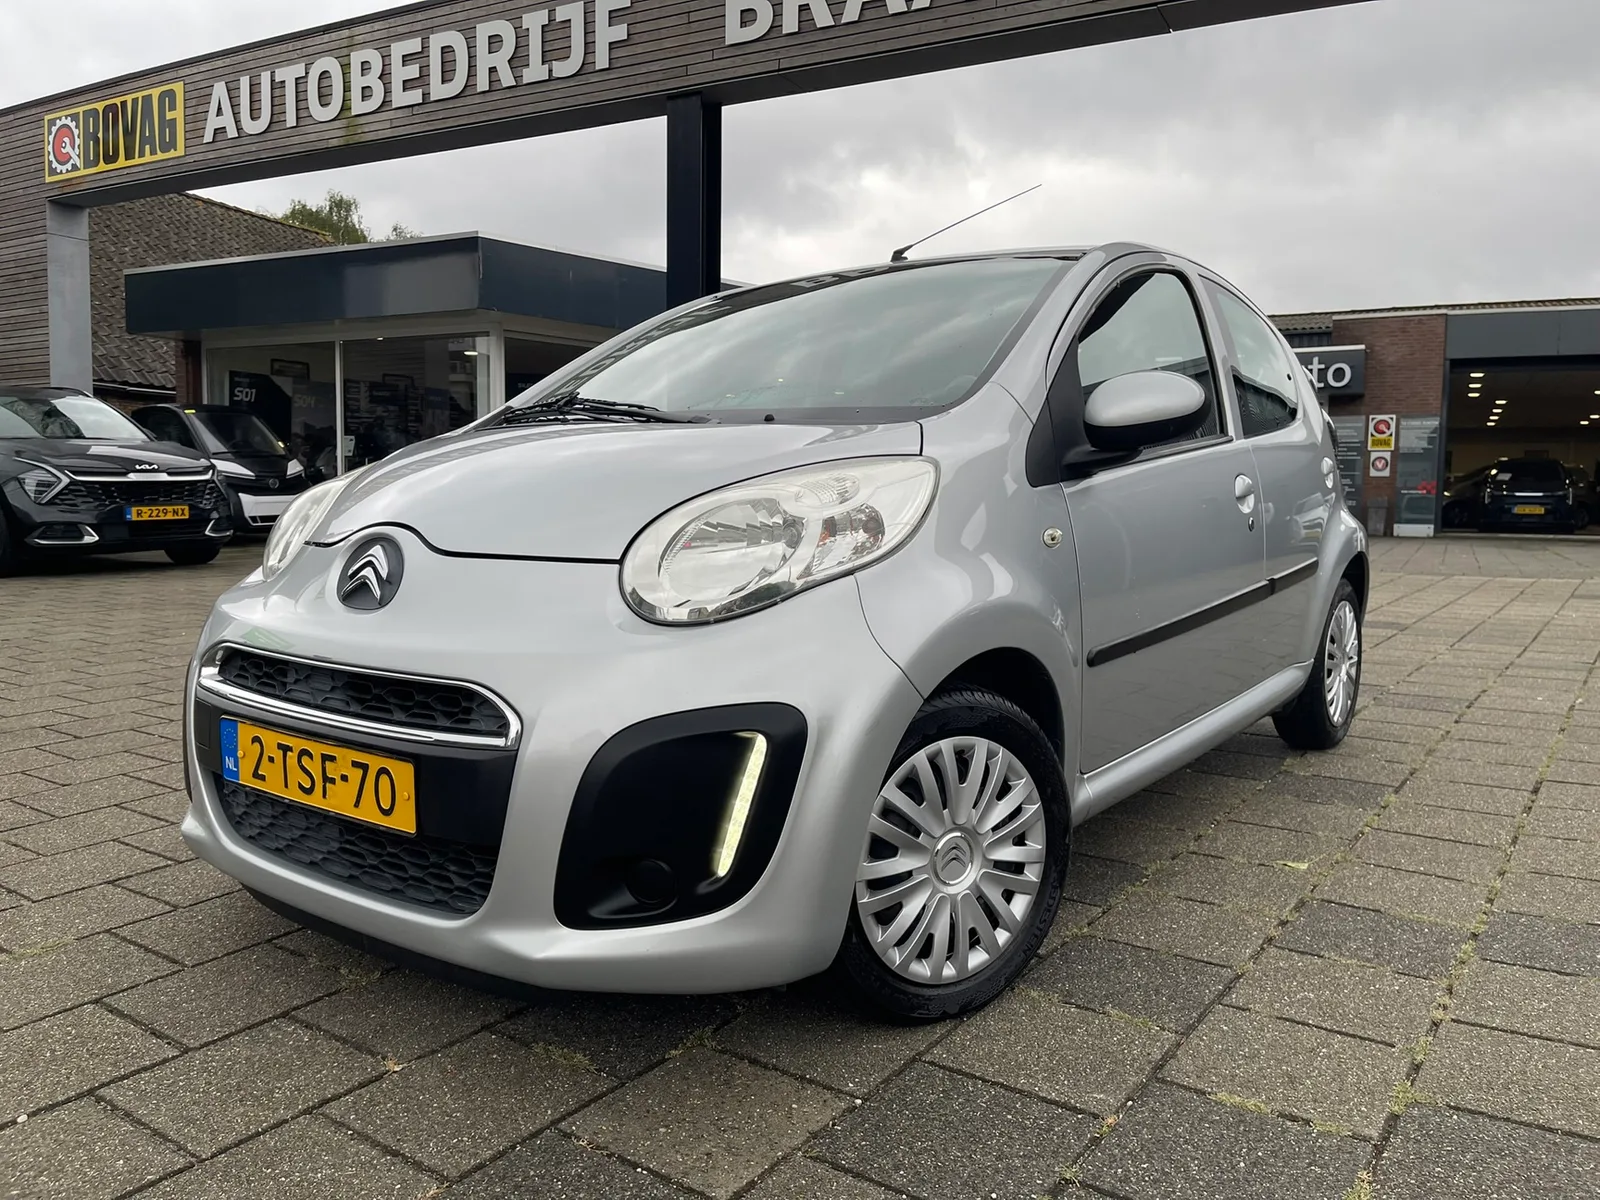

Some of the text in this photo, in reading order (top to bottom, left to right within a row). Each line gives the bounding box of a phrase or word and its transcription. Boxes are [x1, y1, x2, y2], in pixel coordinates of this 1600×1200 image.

[203, 0, 632, 144] AUTOBEDRIJF
[82, 88, 178, 170] BOVAG
[1371, 437, 1391, 448] BOVAG
[136, 507, 187, 519] R-229-NX
[225, 755, 238, 772] NL
[251, 735, 397, 817] 2-TSF-70
